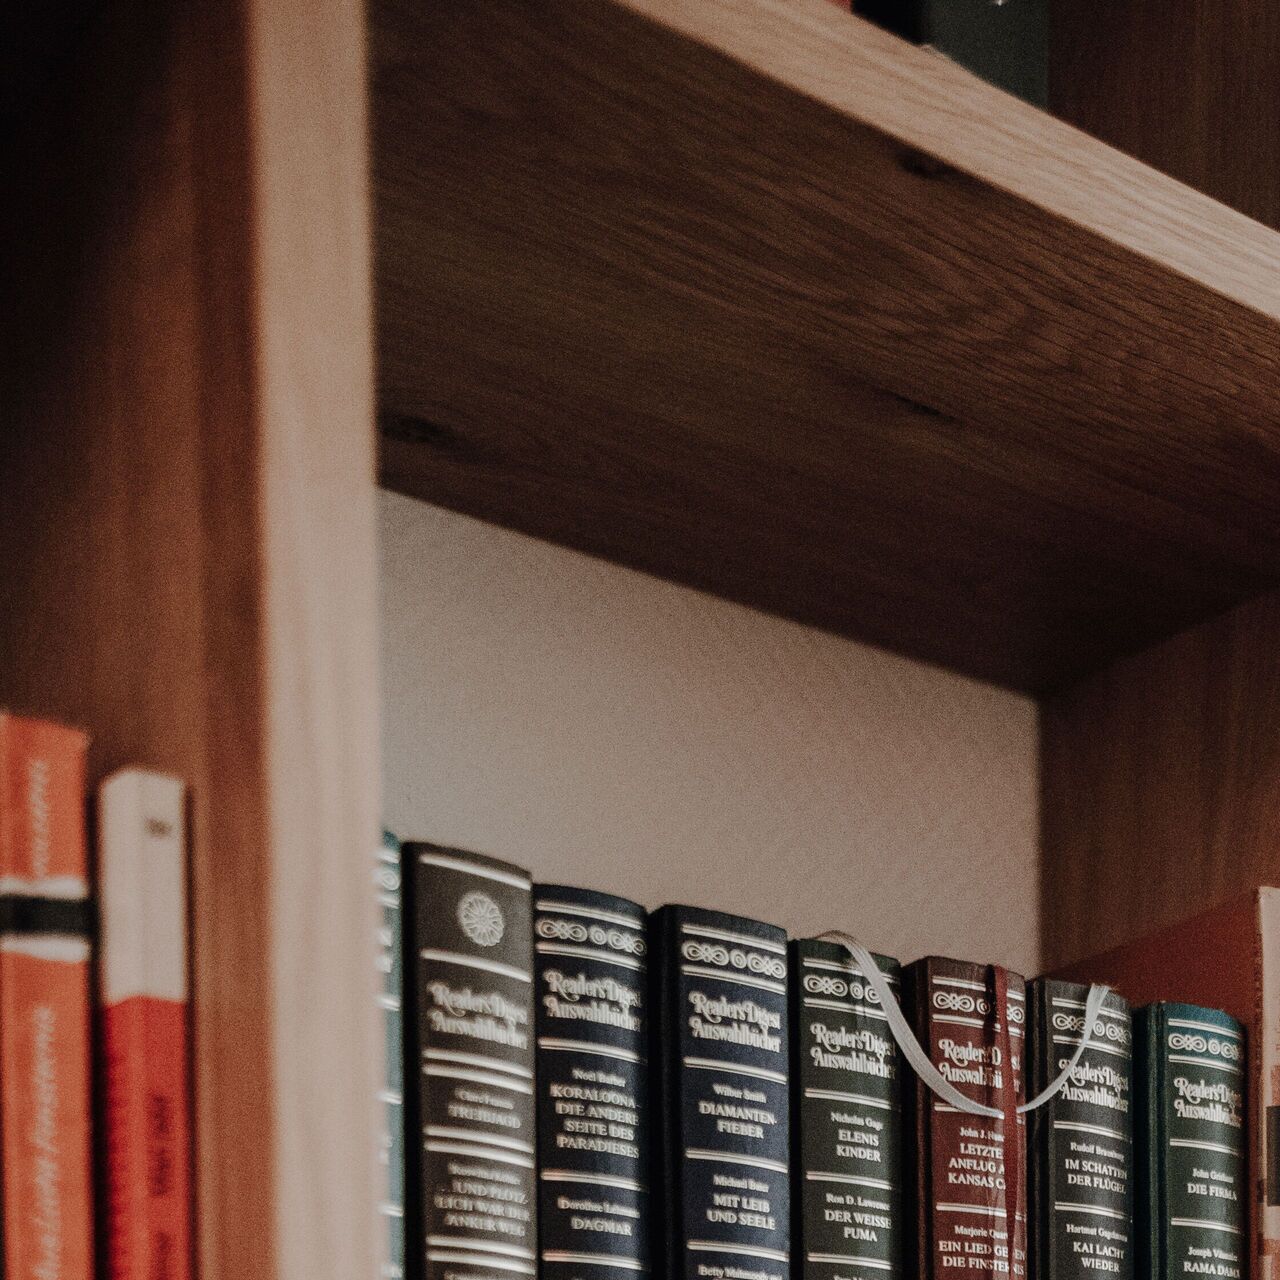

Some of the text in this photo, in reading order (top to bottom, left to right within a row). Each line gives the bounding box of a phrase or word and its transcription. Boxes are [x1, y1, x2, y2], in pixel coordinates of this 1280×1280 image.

[688, 990, 781, 1031] Reader's Digest
[688, 1014, 781, 1053] Auswahlbücher
[810, 1021, 864, 1053] Reader's
[1174, 1077, 1220, 1104] Reader's
[555, 1101, 639, 1126] DIE ANDERE
[563, 1118, 635, 1141] SEITE DES
[717, 1119, 764, 1139] FIEBER
[838, 1129, 880, 1147] ELENIS
[556, 1134, 640, 1159] PARADIESES
[836, 1145, 882, 1163] KINDER
[949, 1157, 996, 1172] ANFLUG
[1065, 1158, 1128, 1179] IM SCHATTEN
[948, 1172, 994, 1188] KANSAS
[1067, 1173, 1127, 1194] DER FLÜGEL
[1187, 1183, 1237, 1201] DIE FIRMA
[713, 1193, 771, 1213] MIT LEIB
[571, 1216, 633, 1236] DAGMAR
[707, 1210, 776, 1230] UND SEELE
[824, 1209, 892, 1229] DER WEISSE
[843, 1226, 878, 1243] PUMA
[938, 1241, 962, 1252] EIN
[1073, 1241, 1125, 1260] KAI LACHT
[942, 1256, 966, 1268] DIE
[1081, 1257, 1121, 1273] WIEDER
[1184, 1261, 1216, 1275] RAMA
